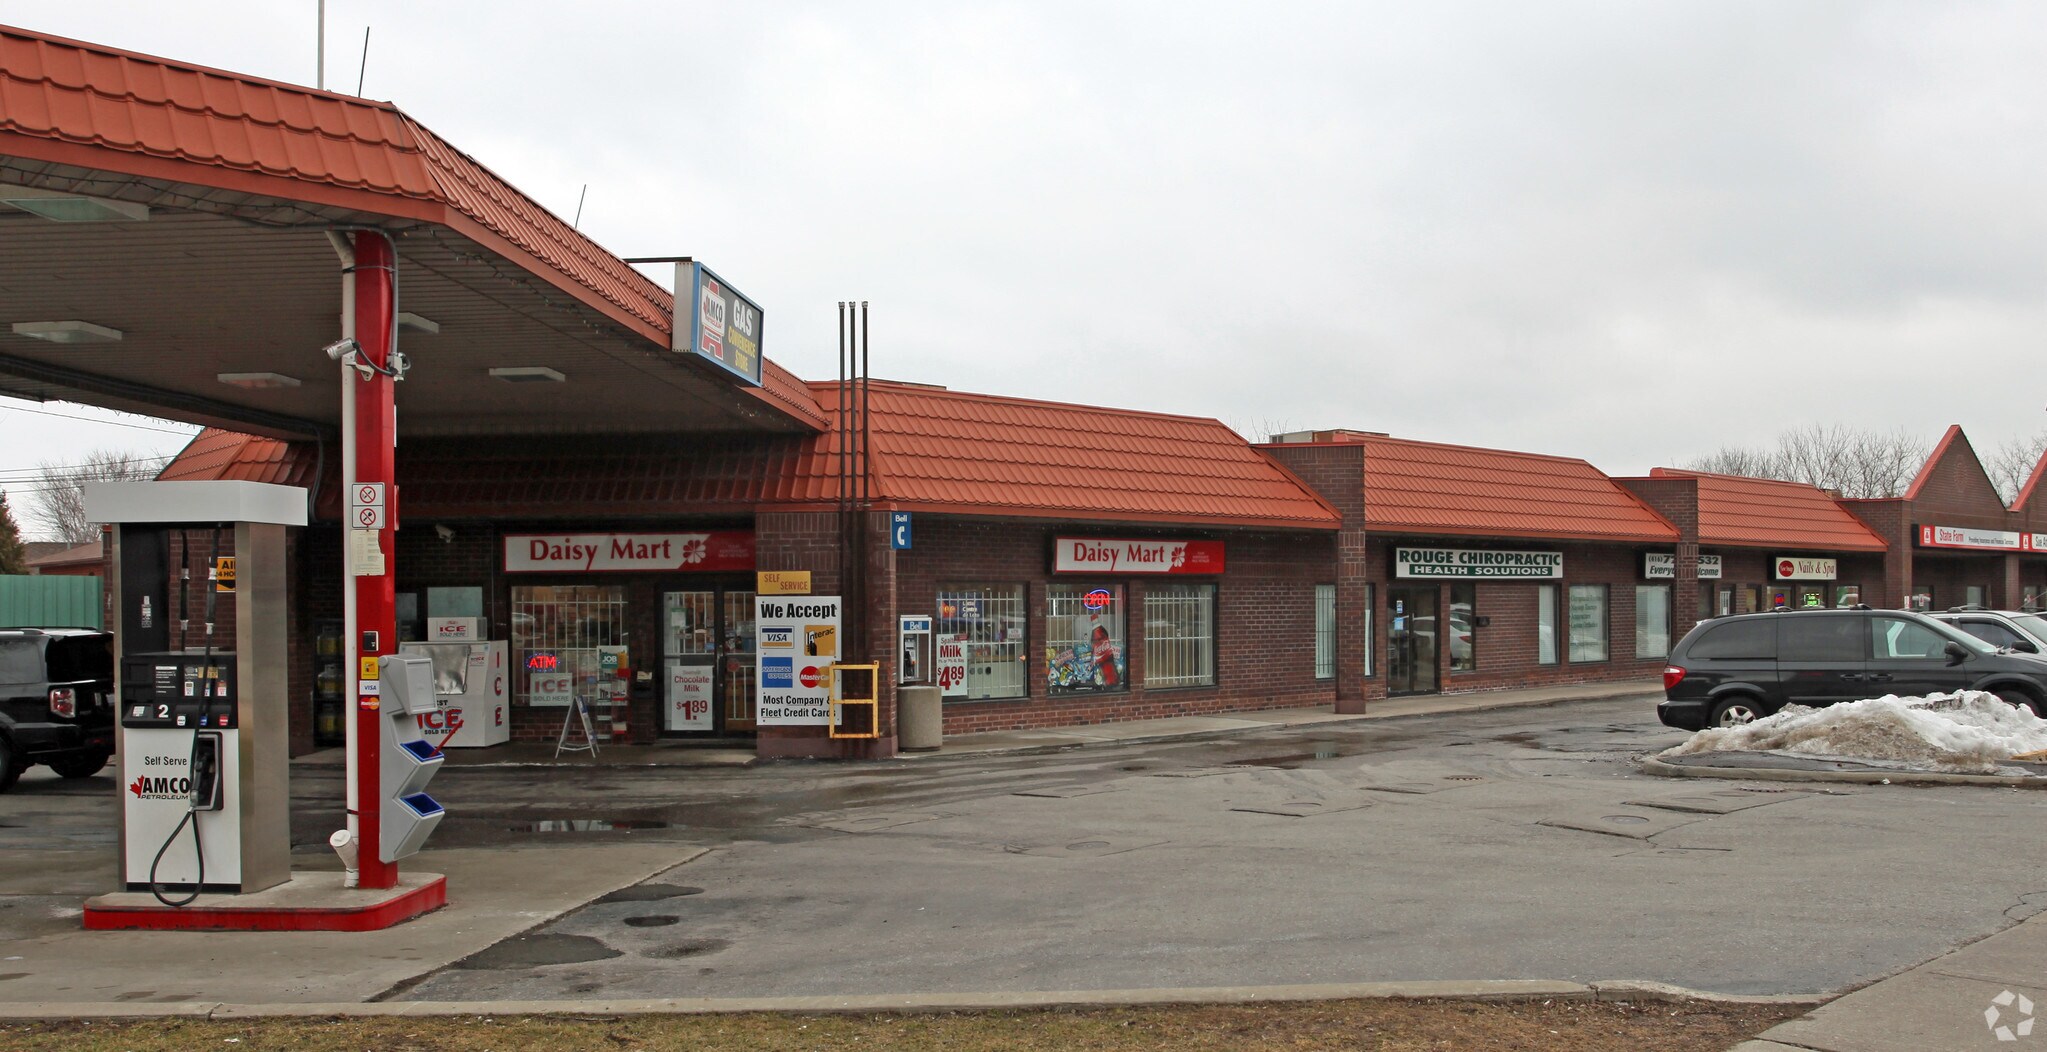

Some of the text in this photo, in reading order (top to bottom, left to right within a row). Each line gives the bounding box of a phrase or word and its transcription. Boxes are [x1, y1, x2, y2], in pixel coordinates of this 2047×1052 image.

[707, 296, 723, 323] AMCO
[733, 299, 753, 337] GAS
[895, 514, 908, 522] Bell
[1939, 528, 1964, 542] State Farm
[530, 538, 671, 570] Daisy Mart
[1073, 542, 1119, 571] Daisy
[1127, 544, 1165, 563] Mart
[1399, 550, 1561, 566] ROUGE CHIROPRACTIC
[1414, 566, 1548, 575] HEALTH SOLUTIONS
[1797, 560, 1814, 574] Nails
[1815, 560, 1821, 574] &
[1823, 561, 1835, 577] Spa
[764, 573, 780, 582] SELF
[780, 581, 808, 590] SERVICE
[1083, 593, 1110, 606] OPEN
[760, 603, 837, 619] We Accept
[909, 621, 923, 630] Bell
[767, 633, 787, 641] VISA
[940, 645, 962, 658] Milk
[529, 656, 557, 668] ATM
[602, 655, 617, 663] JOB
[674, 675, 710, 683] Chocolate
[534, 679, 569, 693] ICE
[763, 695, 784, 704] Most
[786, 695, 824, 706] Company
[158, 704, 169, 718] 2
[761, 708, 782, 717] Fleet
[784, 708, 809, 717] Credit
[417, 708, 463, 730] ICE
[144, 756, 188, 766] Self Serve
[142, 777, 191, 794] AMCO
